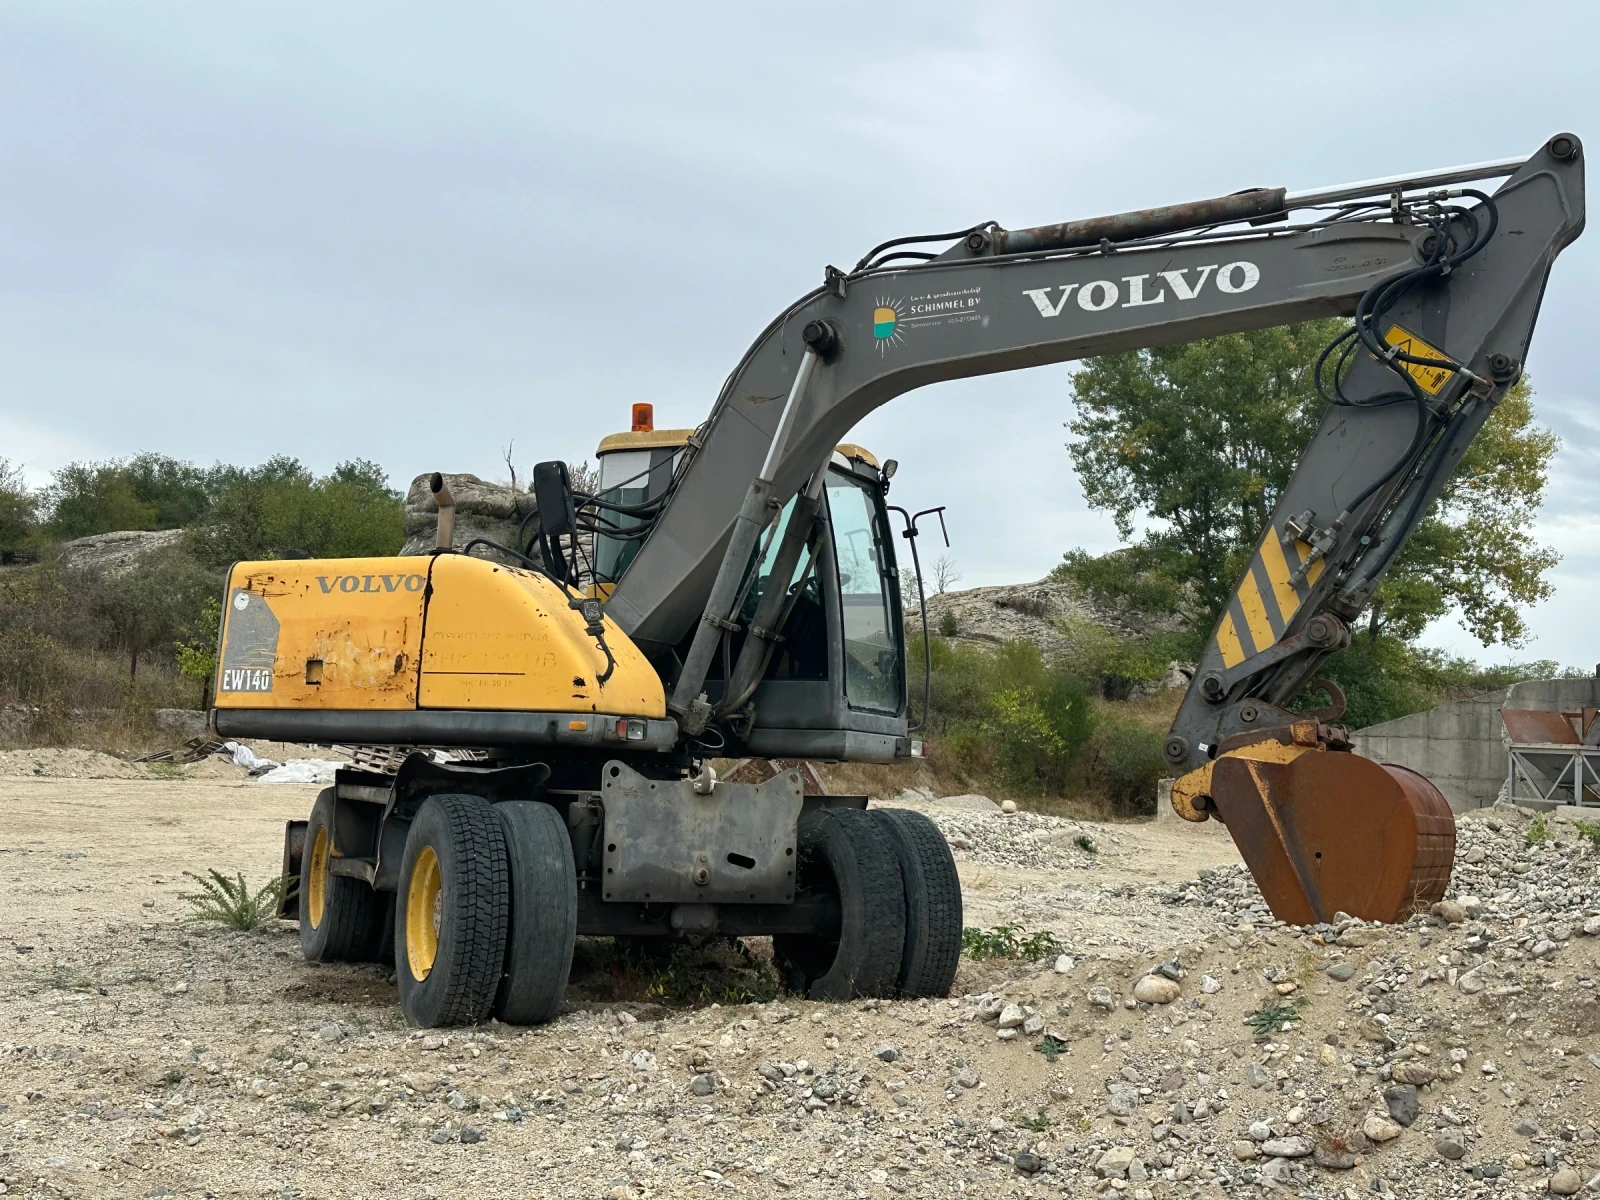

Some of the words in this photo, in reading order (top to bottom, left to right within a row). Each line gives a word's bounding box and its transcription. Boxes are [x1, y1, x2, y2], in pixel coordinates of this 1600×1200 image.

[1022, 261, 1260, 317] VOLVO
[910, 299, 965, 314] SCHIMMEL
[968, 297, 981, 307] BV
[315, 574, 426, 594] VOLVO
[222, 669, 270, 690] EW140
